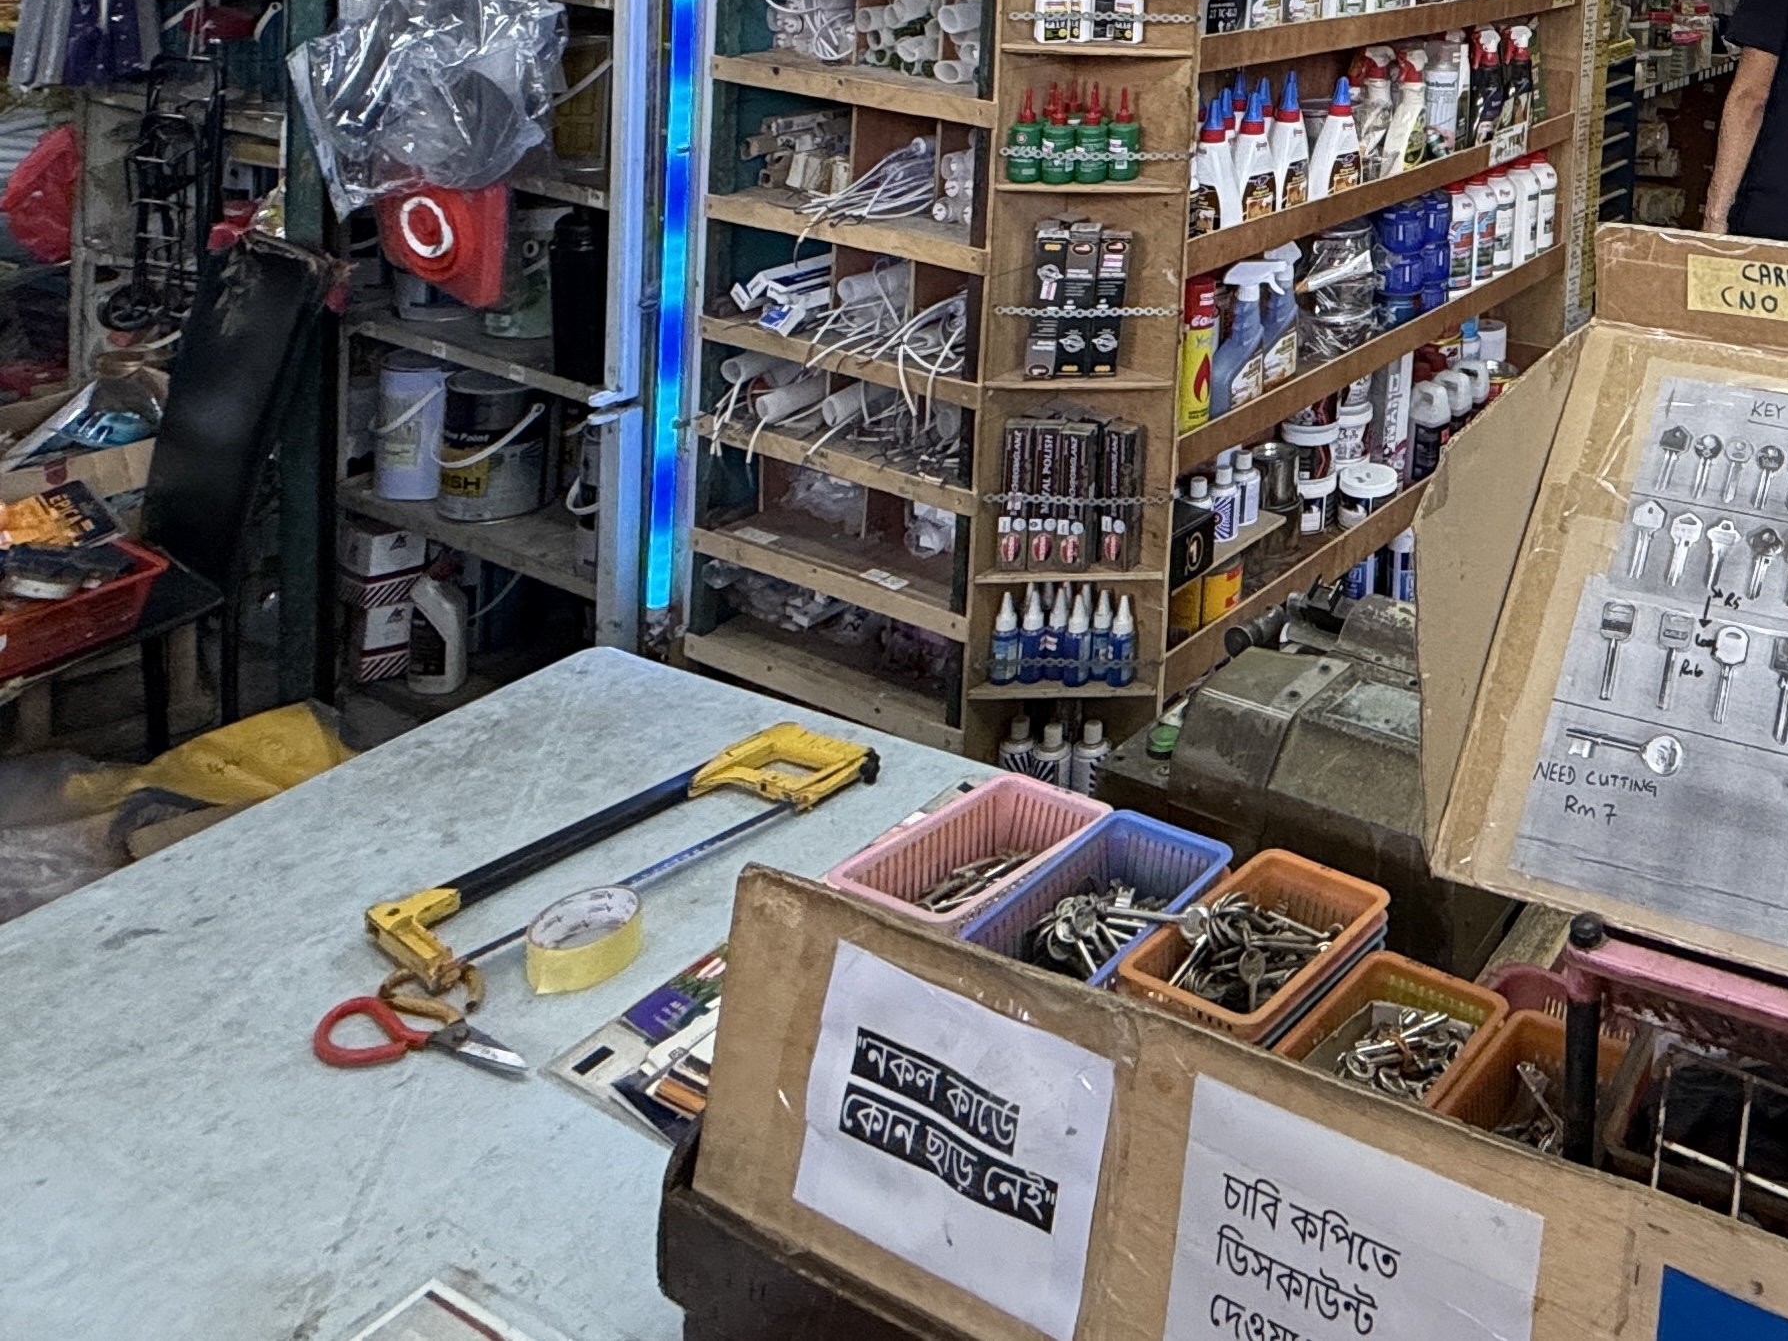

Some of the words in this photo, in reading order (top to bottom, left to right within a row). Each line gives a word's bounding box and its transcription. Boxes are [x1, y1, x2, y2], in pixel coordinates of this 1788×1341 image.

[1721, 285, 1779, 314] (NO
[1751, 400, 1787, 424] KEY
[1532, 760, 1577, 786] NEED
[1586, 770, 1658, 798] CUTTING
[842, 1092, 921, 1156] কোন
[924, 1124, 979, 1193] ছাড়
[945, 1075, 1020, 1146] কার্ডে
[1222, 1172, 1283, 1232] চাবি
[1288, 1202, 1402, 1280] কপিতে
[1215, 1223, 1379, 1336] ডিসকাউন্ট
